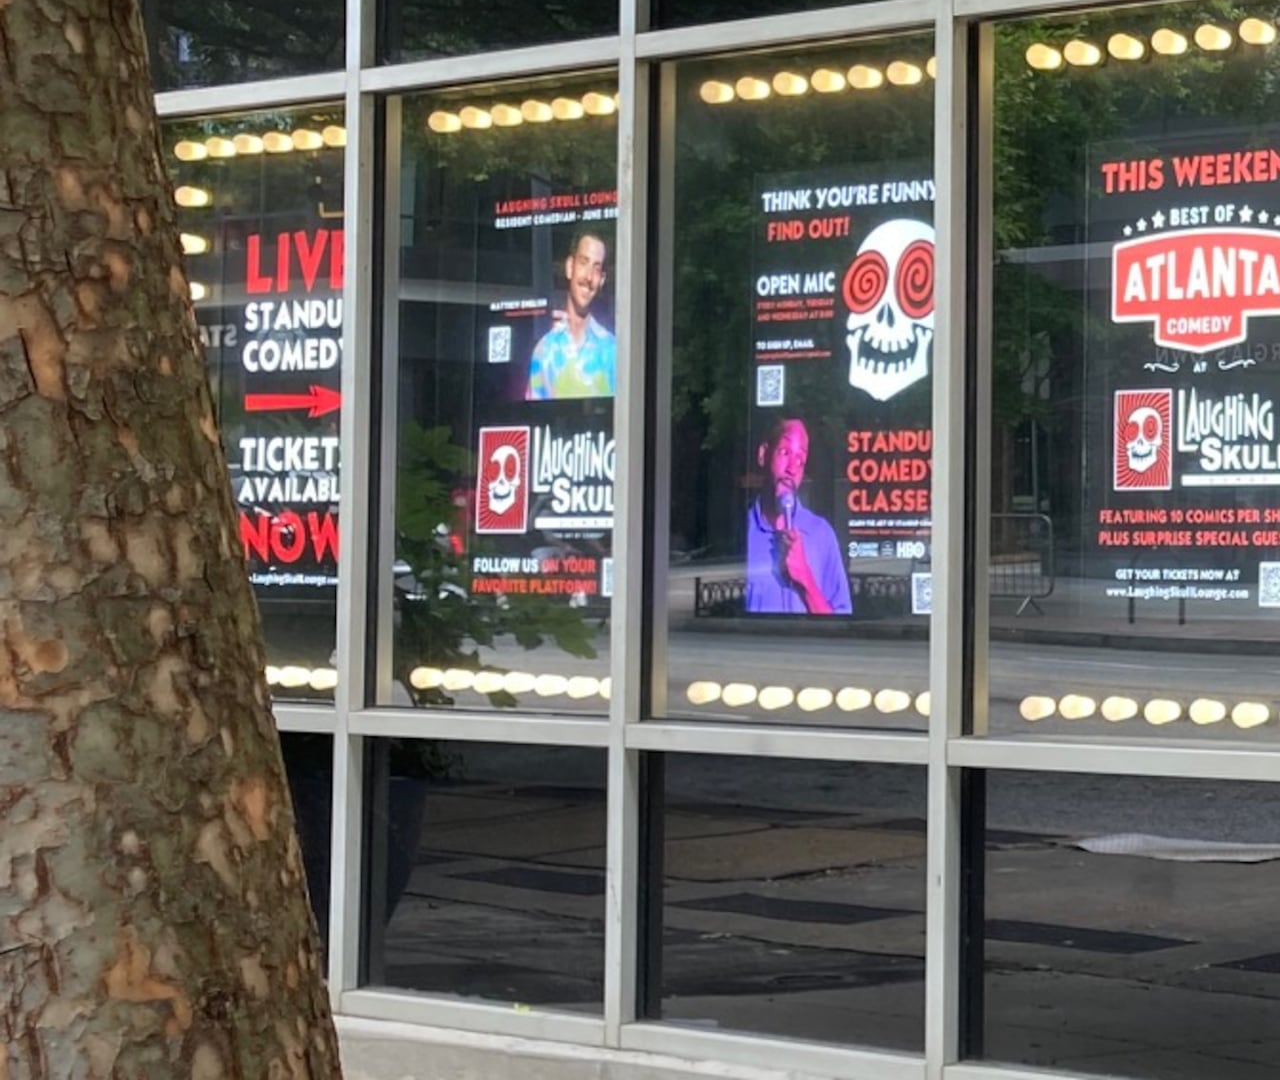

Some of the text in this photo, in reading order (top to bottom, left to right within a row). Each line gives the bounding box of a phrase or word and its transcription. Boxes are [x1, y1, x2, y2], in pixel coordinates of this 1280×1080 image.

[1102, 158, 1163, 193] THIS
[762, 189, 811, 213] THINK
[815, 184, 879, 208] YOU'RE
[1170, 204, 1235, 226] BEST OF
[767, 217, 850, 241] FIND OUT!
[757, 272, 835, 296] OPEN MIC
[1123, 246, 1280, 303] ATLANTA
[1166, 316, 1232, 334] COMEDY
[242, 337, 344, 373] COMED
[1193, 361, 1208, 373] AT
[239, 436, 342, 472] TICKET
[848, 458, 932, 482] COMED
[848, 489, 932, 512] CLASSE
[1100, 510, 1167, 524] FEATURING
[1170, 510, 1184, 523] 10
[1186, 510, 1234, 524] COMICS
[1237, 509, 1260, 523] PER
[239, 509, 341, 564] NOW
[1099, 531, 1129, 546] PLUS
[1132, 531, 1192, 546] SURPRISE
[1195, 531, 1249, 546] SPECIAL
[896, 542, 925, 558] HBO
[473, 557, 596, 573] FOLLOW US ON YOUR
[1115, 569, 1240, 580] GET YOUR TICKETS NOW AT
[472, 578, 528, 593] FAVORITE
